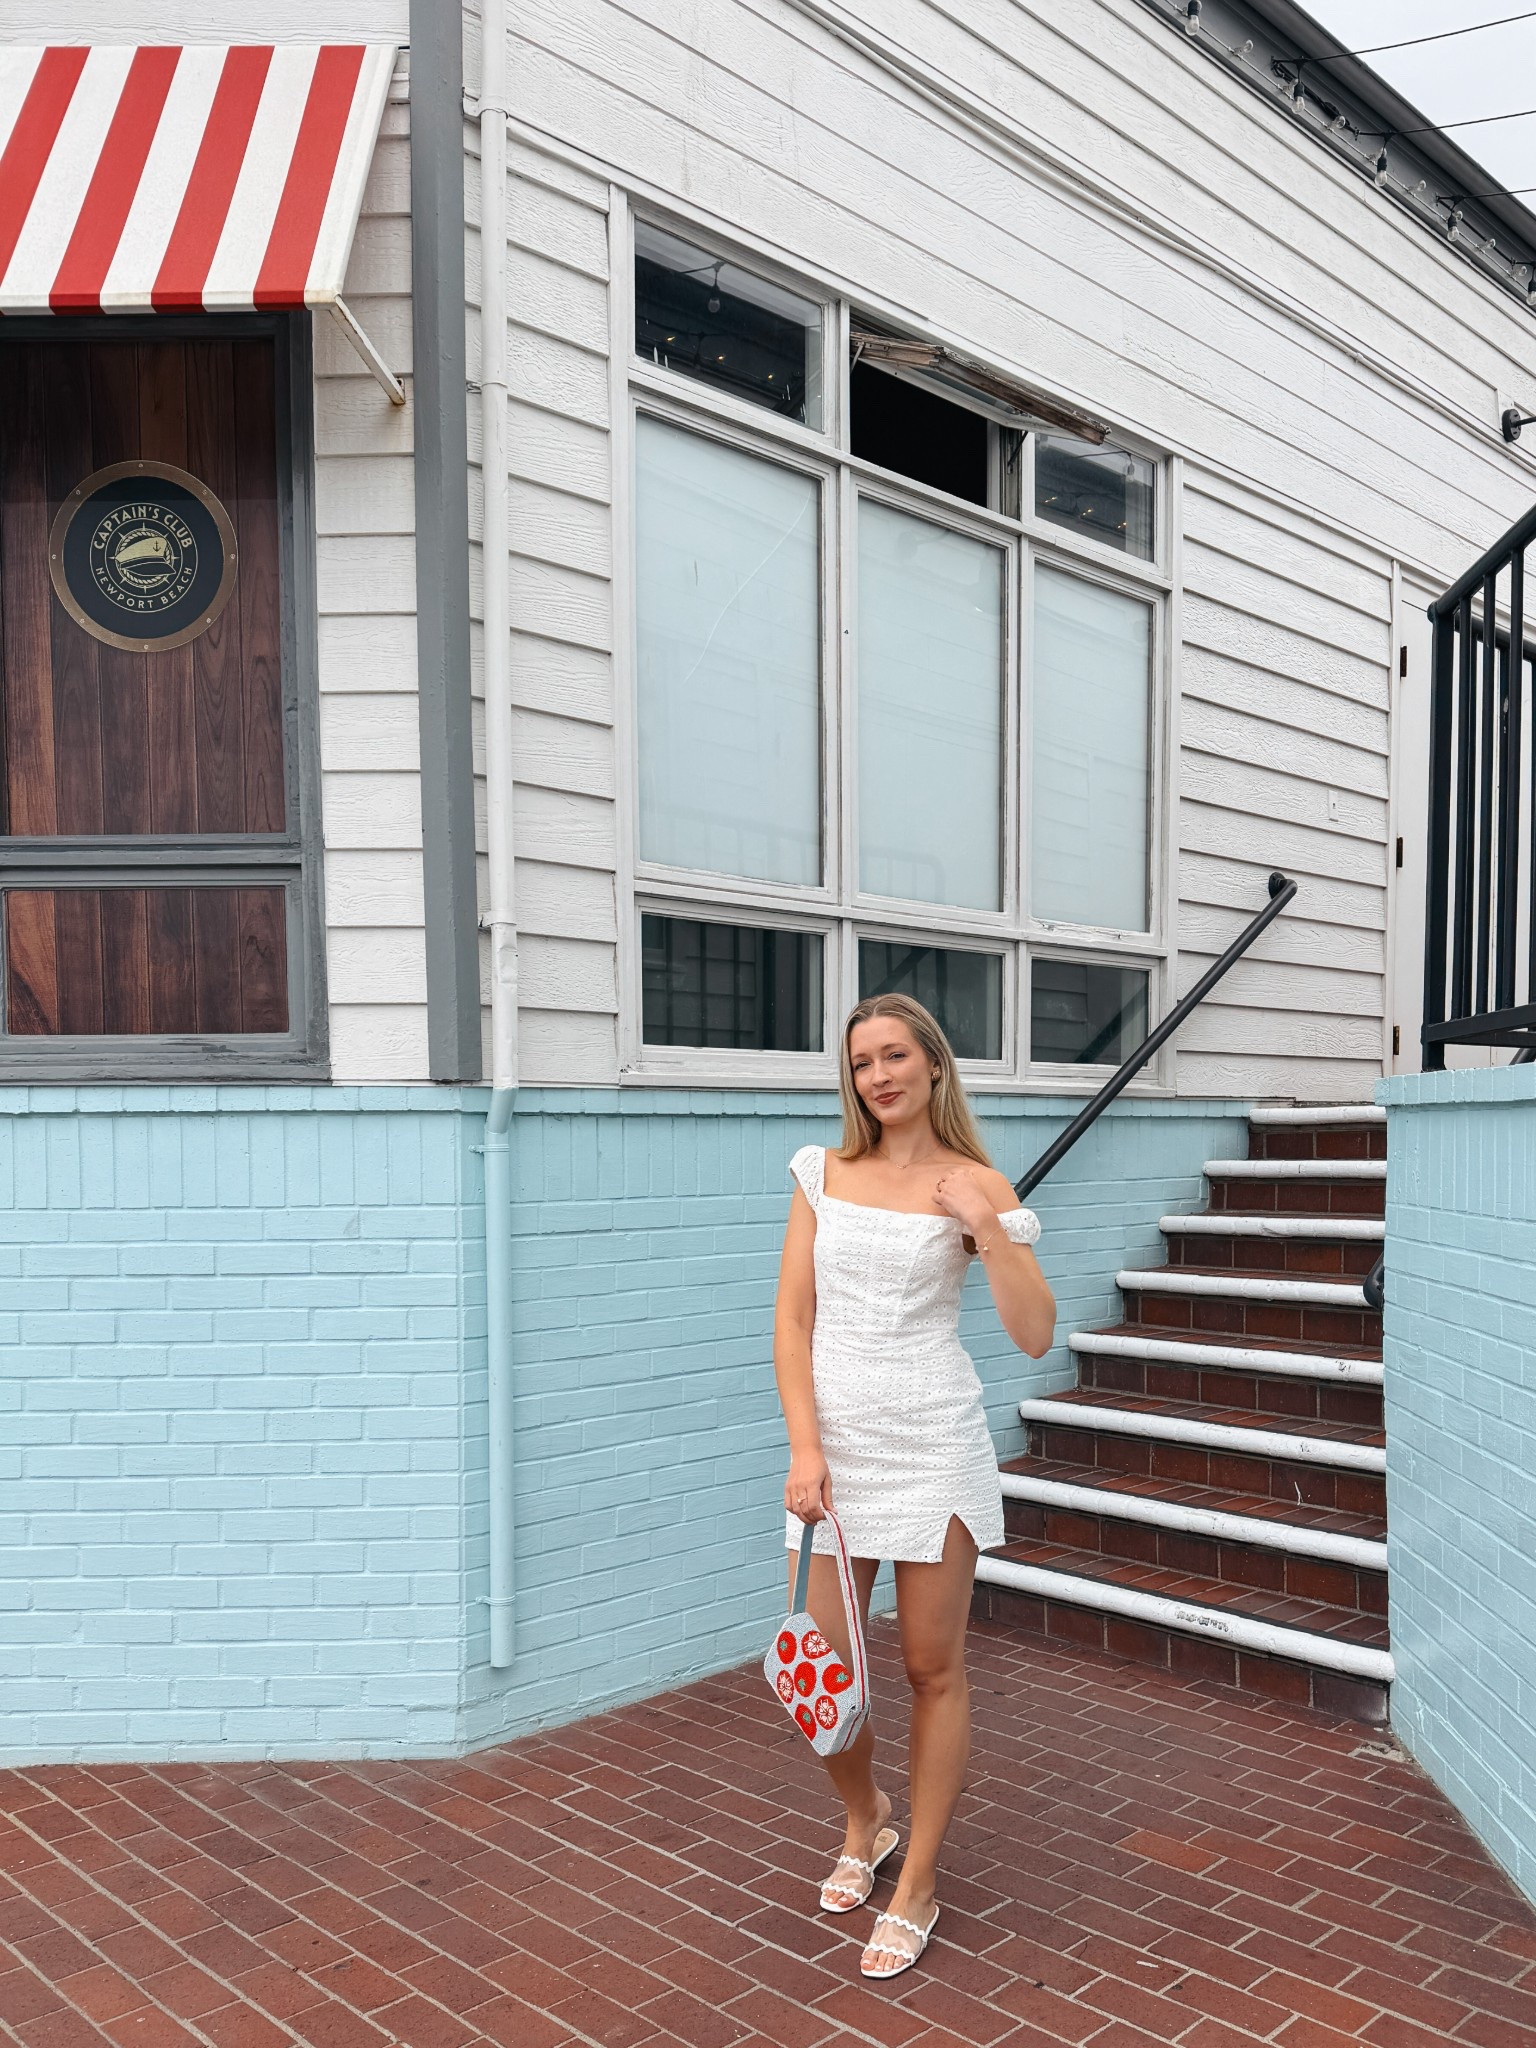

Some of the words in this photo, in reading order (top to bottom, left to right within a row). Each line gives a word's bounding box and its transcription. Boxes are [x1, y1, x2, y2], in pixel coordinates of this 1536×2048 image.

[93, 505, 160, 550] CAPTAIN'S
[163, 514, 193, 548] CLUB
[95, 567, 154, 609] NEWPORT
[160, 567, 193, 604] BEACH
